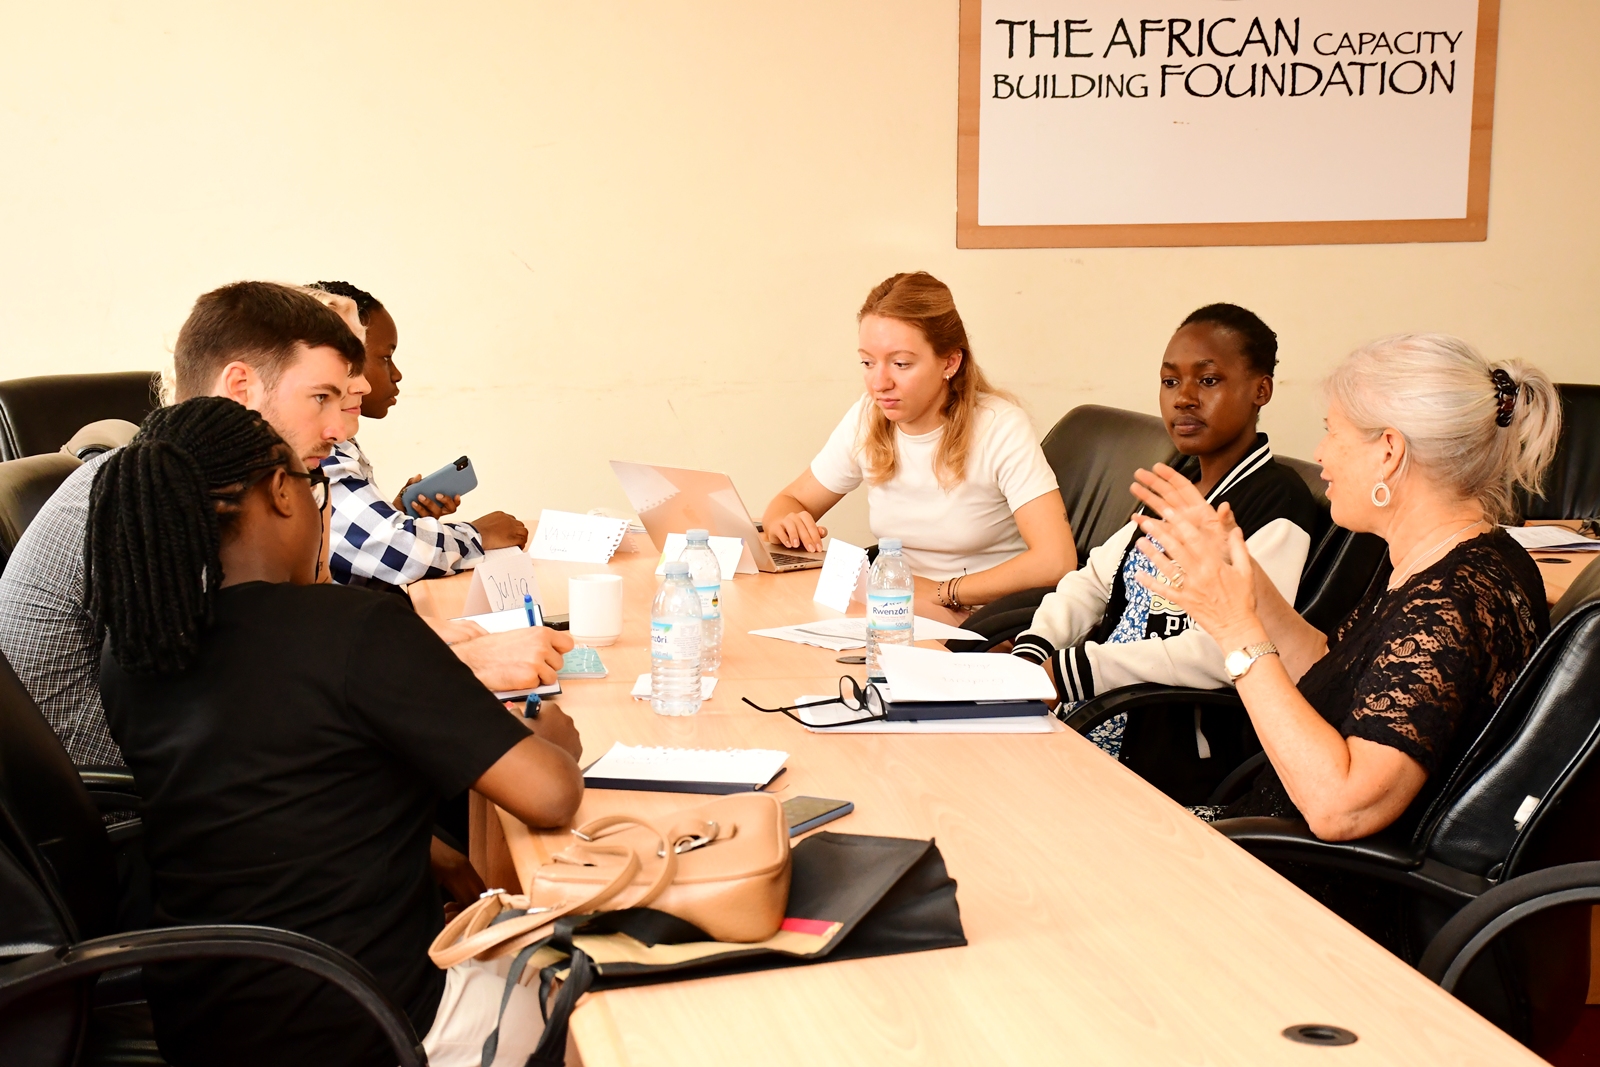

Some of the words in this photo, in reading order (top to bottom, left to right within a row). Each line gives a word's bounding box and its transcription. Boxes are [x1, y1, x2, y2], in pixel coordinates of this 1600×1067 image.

[995, 18, 1094, 59] THE
[1102, 16, 1300, 59] AFRICAN
[1313, 31, 1463, 56] CAPACITY
[992, 73, 1149, 100] BUILDING
[1160, 59, 1456, 99] FOUNDATION
[544, 526, 593, 542] VASHTI
[488, 573, 530, 611] Julia
